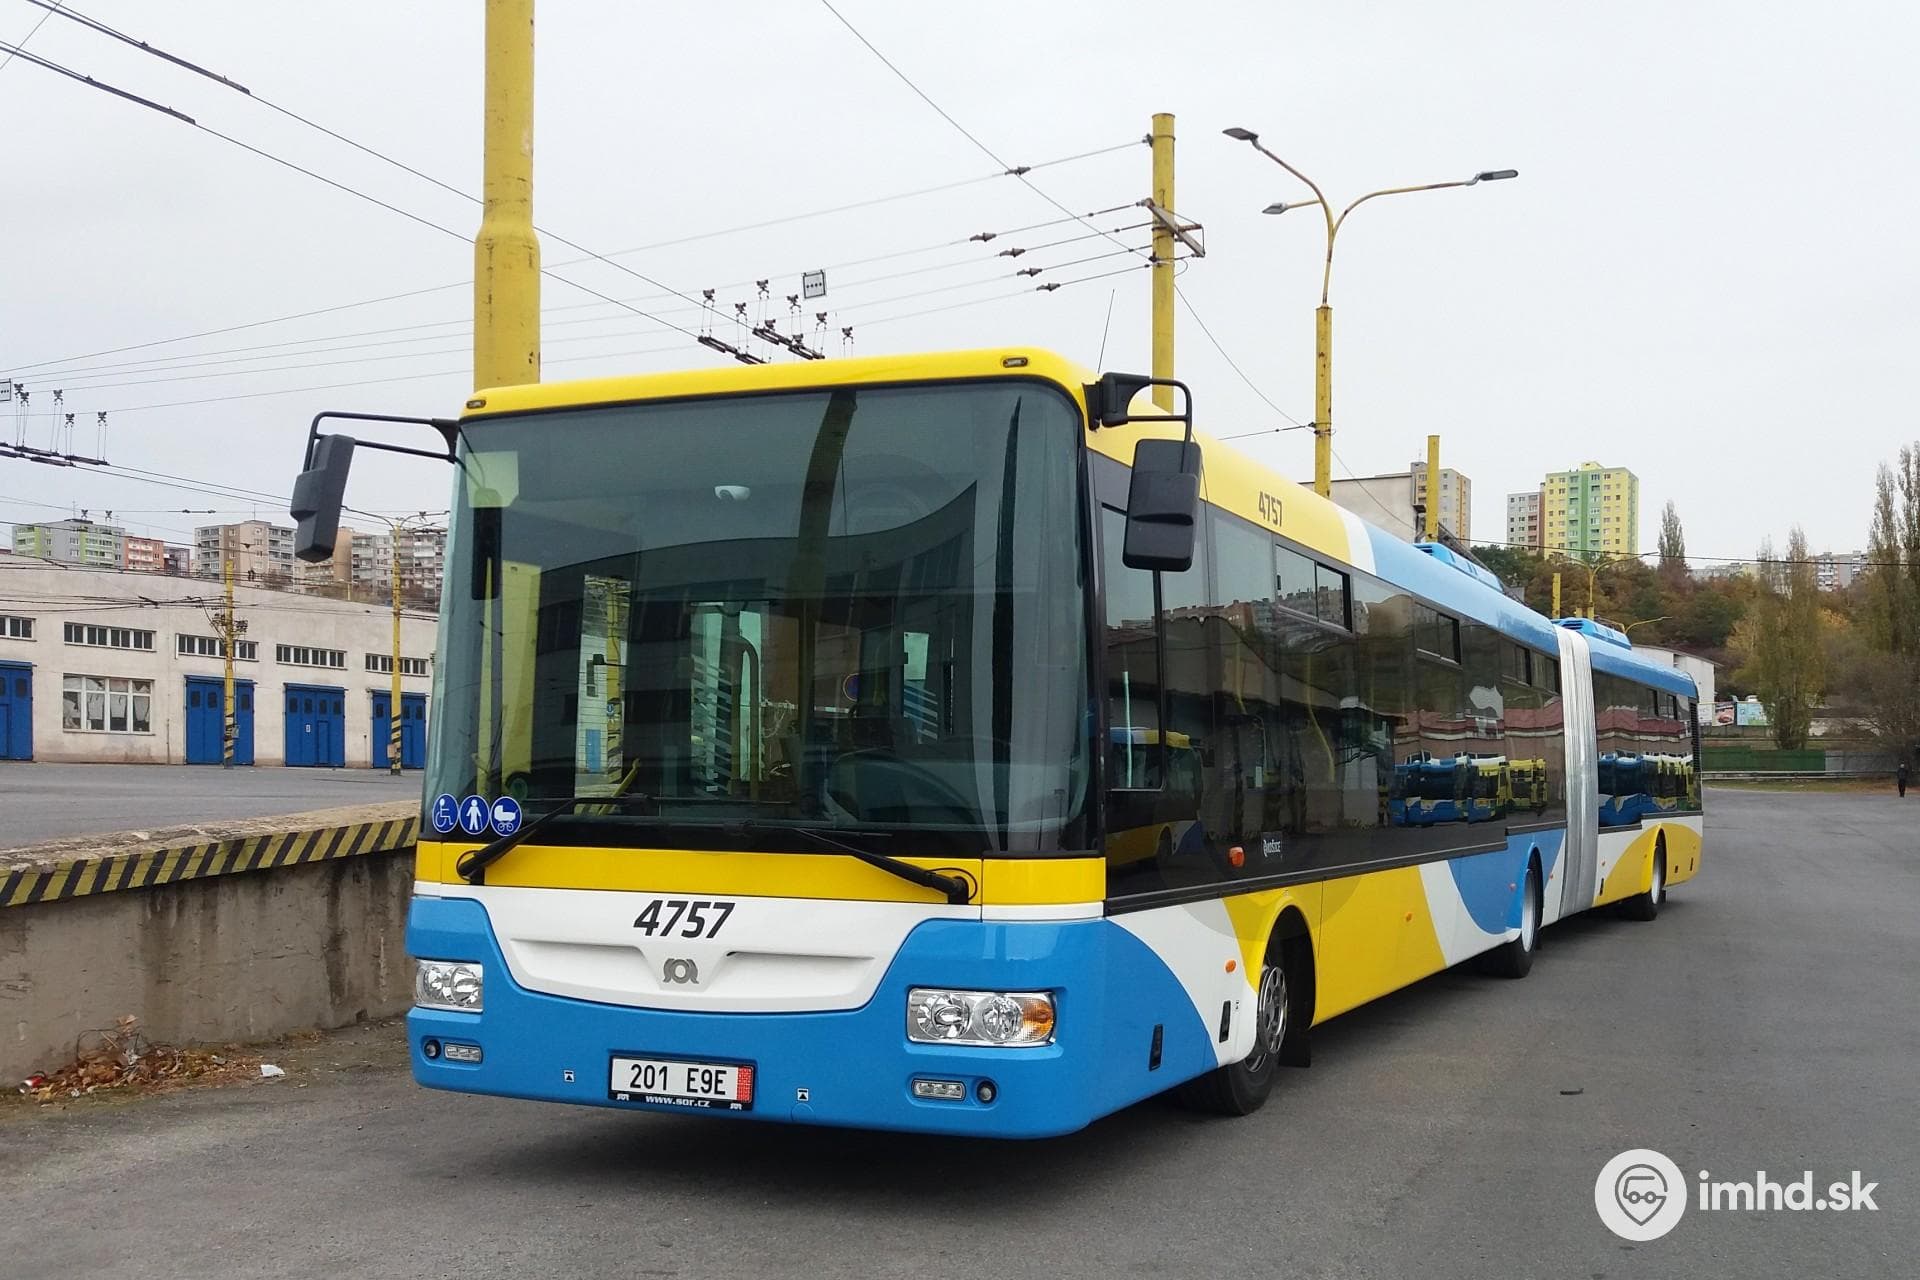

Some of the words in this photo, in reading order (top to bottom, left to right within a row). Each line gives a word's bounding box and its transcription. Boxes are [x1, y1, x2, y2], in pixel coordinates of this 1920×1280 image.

[1259, 490, 1283, 528] 4757
[633, 899, 736, 939] 4757
[629, 1064, 668, 1091] 201
[686, 1067, 727, 1095] E9E
[645, 1096, 711, 1108] www.sor.cz
